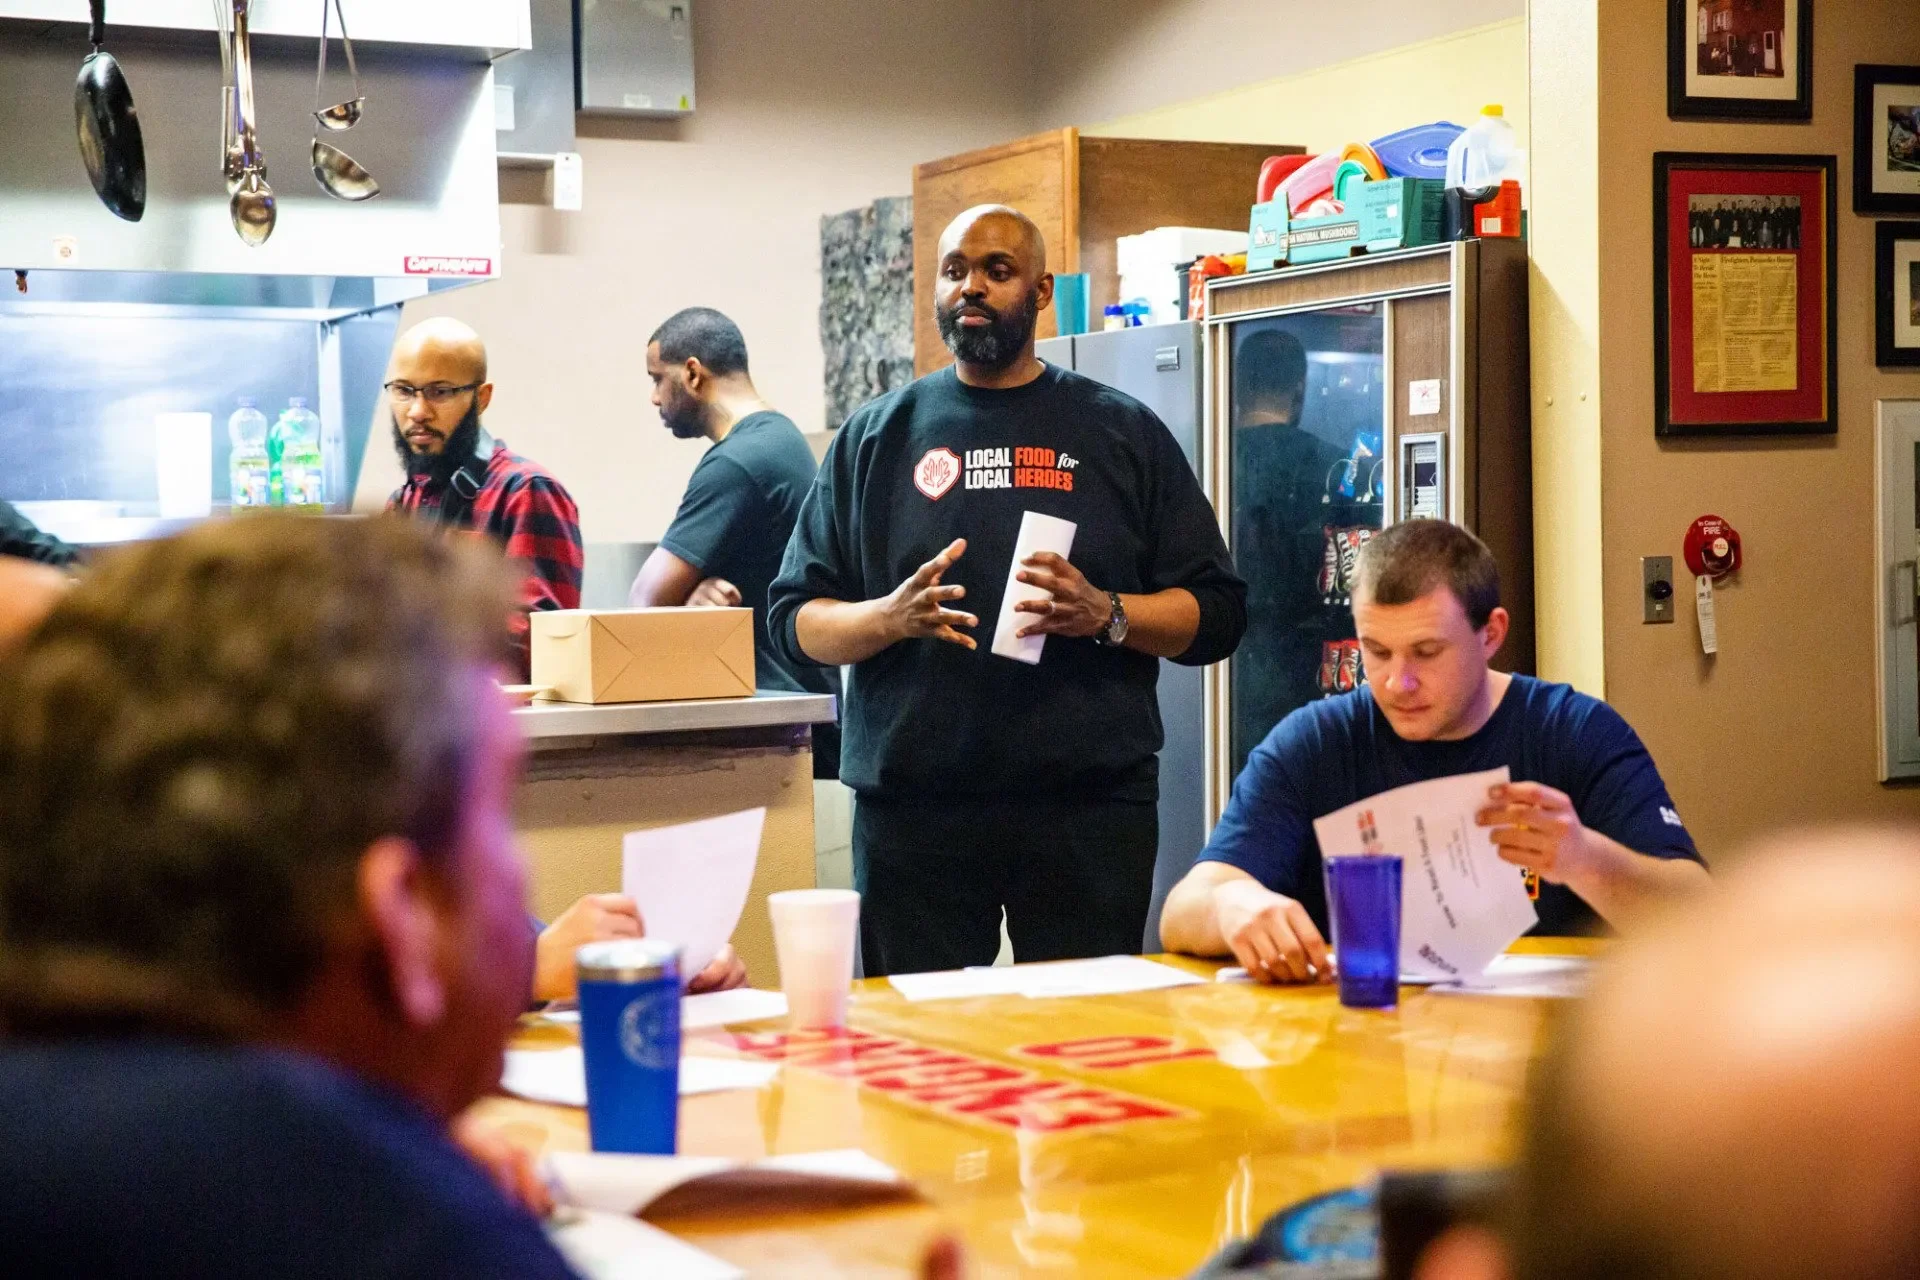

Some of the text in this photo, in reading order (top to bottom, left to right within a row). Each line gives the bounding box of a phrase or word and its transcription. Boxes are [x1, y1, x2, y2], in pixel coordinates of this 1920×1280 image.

[1320, 226, 1357, 240] MUSHROOMS
[965, 447, 1079, 469] LOCAL FOOD for
[965, 468, 1073, 491] LOCAL HEROES
[1703, 526, 1721, 535] FIRE
